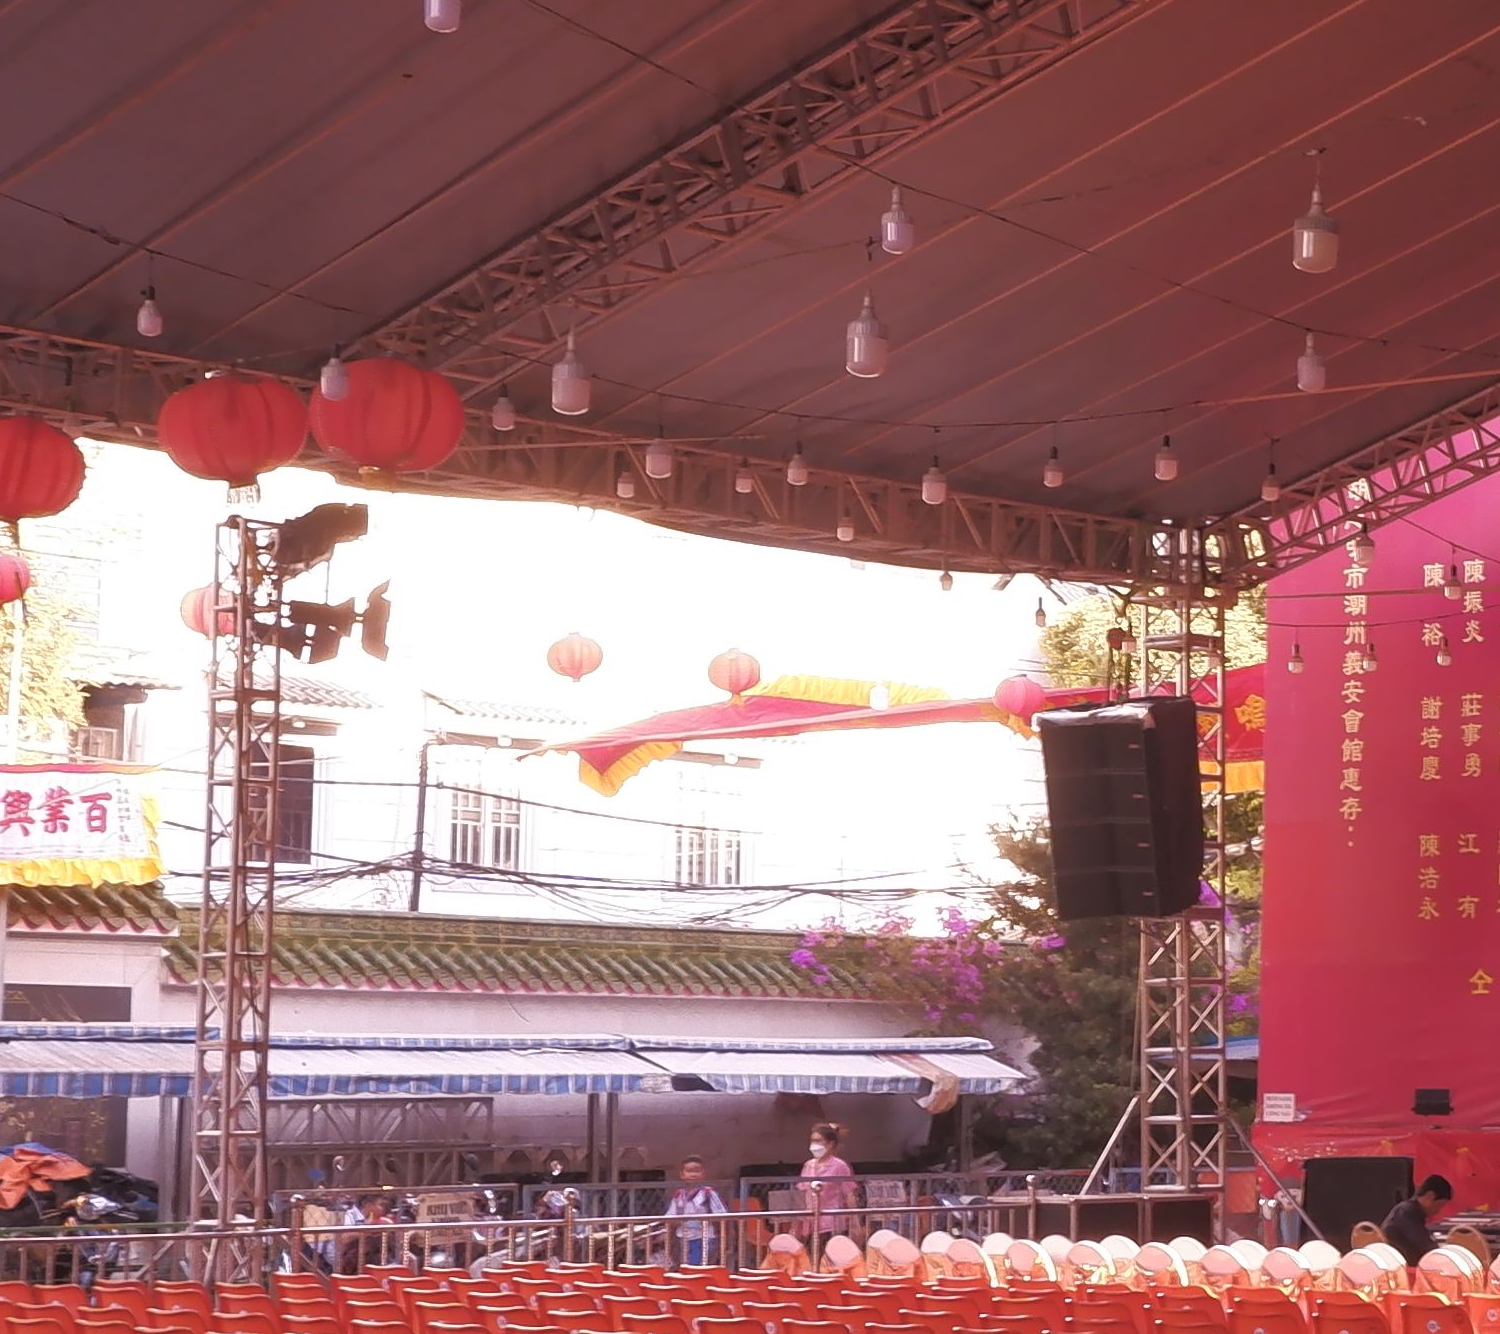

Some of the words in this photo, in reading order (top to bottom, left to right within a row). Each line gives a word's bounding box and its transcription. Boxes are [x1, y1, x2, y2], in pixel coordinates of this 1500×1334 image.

[1461, 559, 1486, 643] 陳振炎
[1420, 695, 1444, 780] 謝培慶
[1460, 693, 1483, 778] 莊事勇
[1417, 833, 1441, 920] 陳浩永
[1456, 833, 1480, 919] 江有
